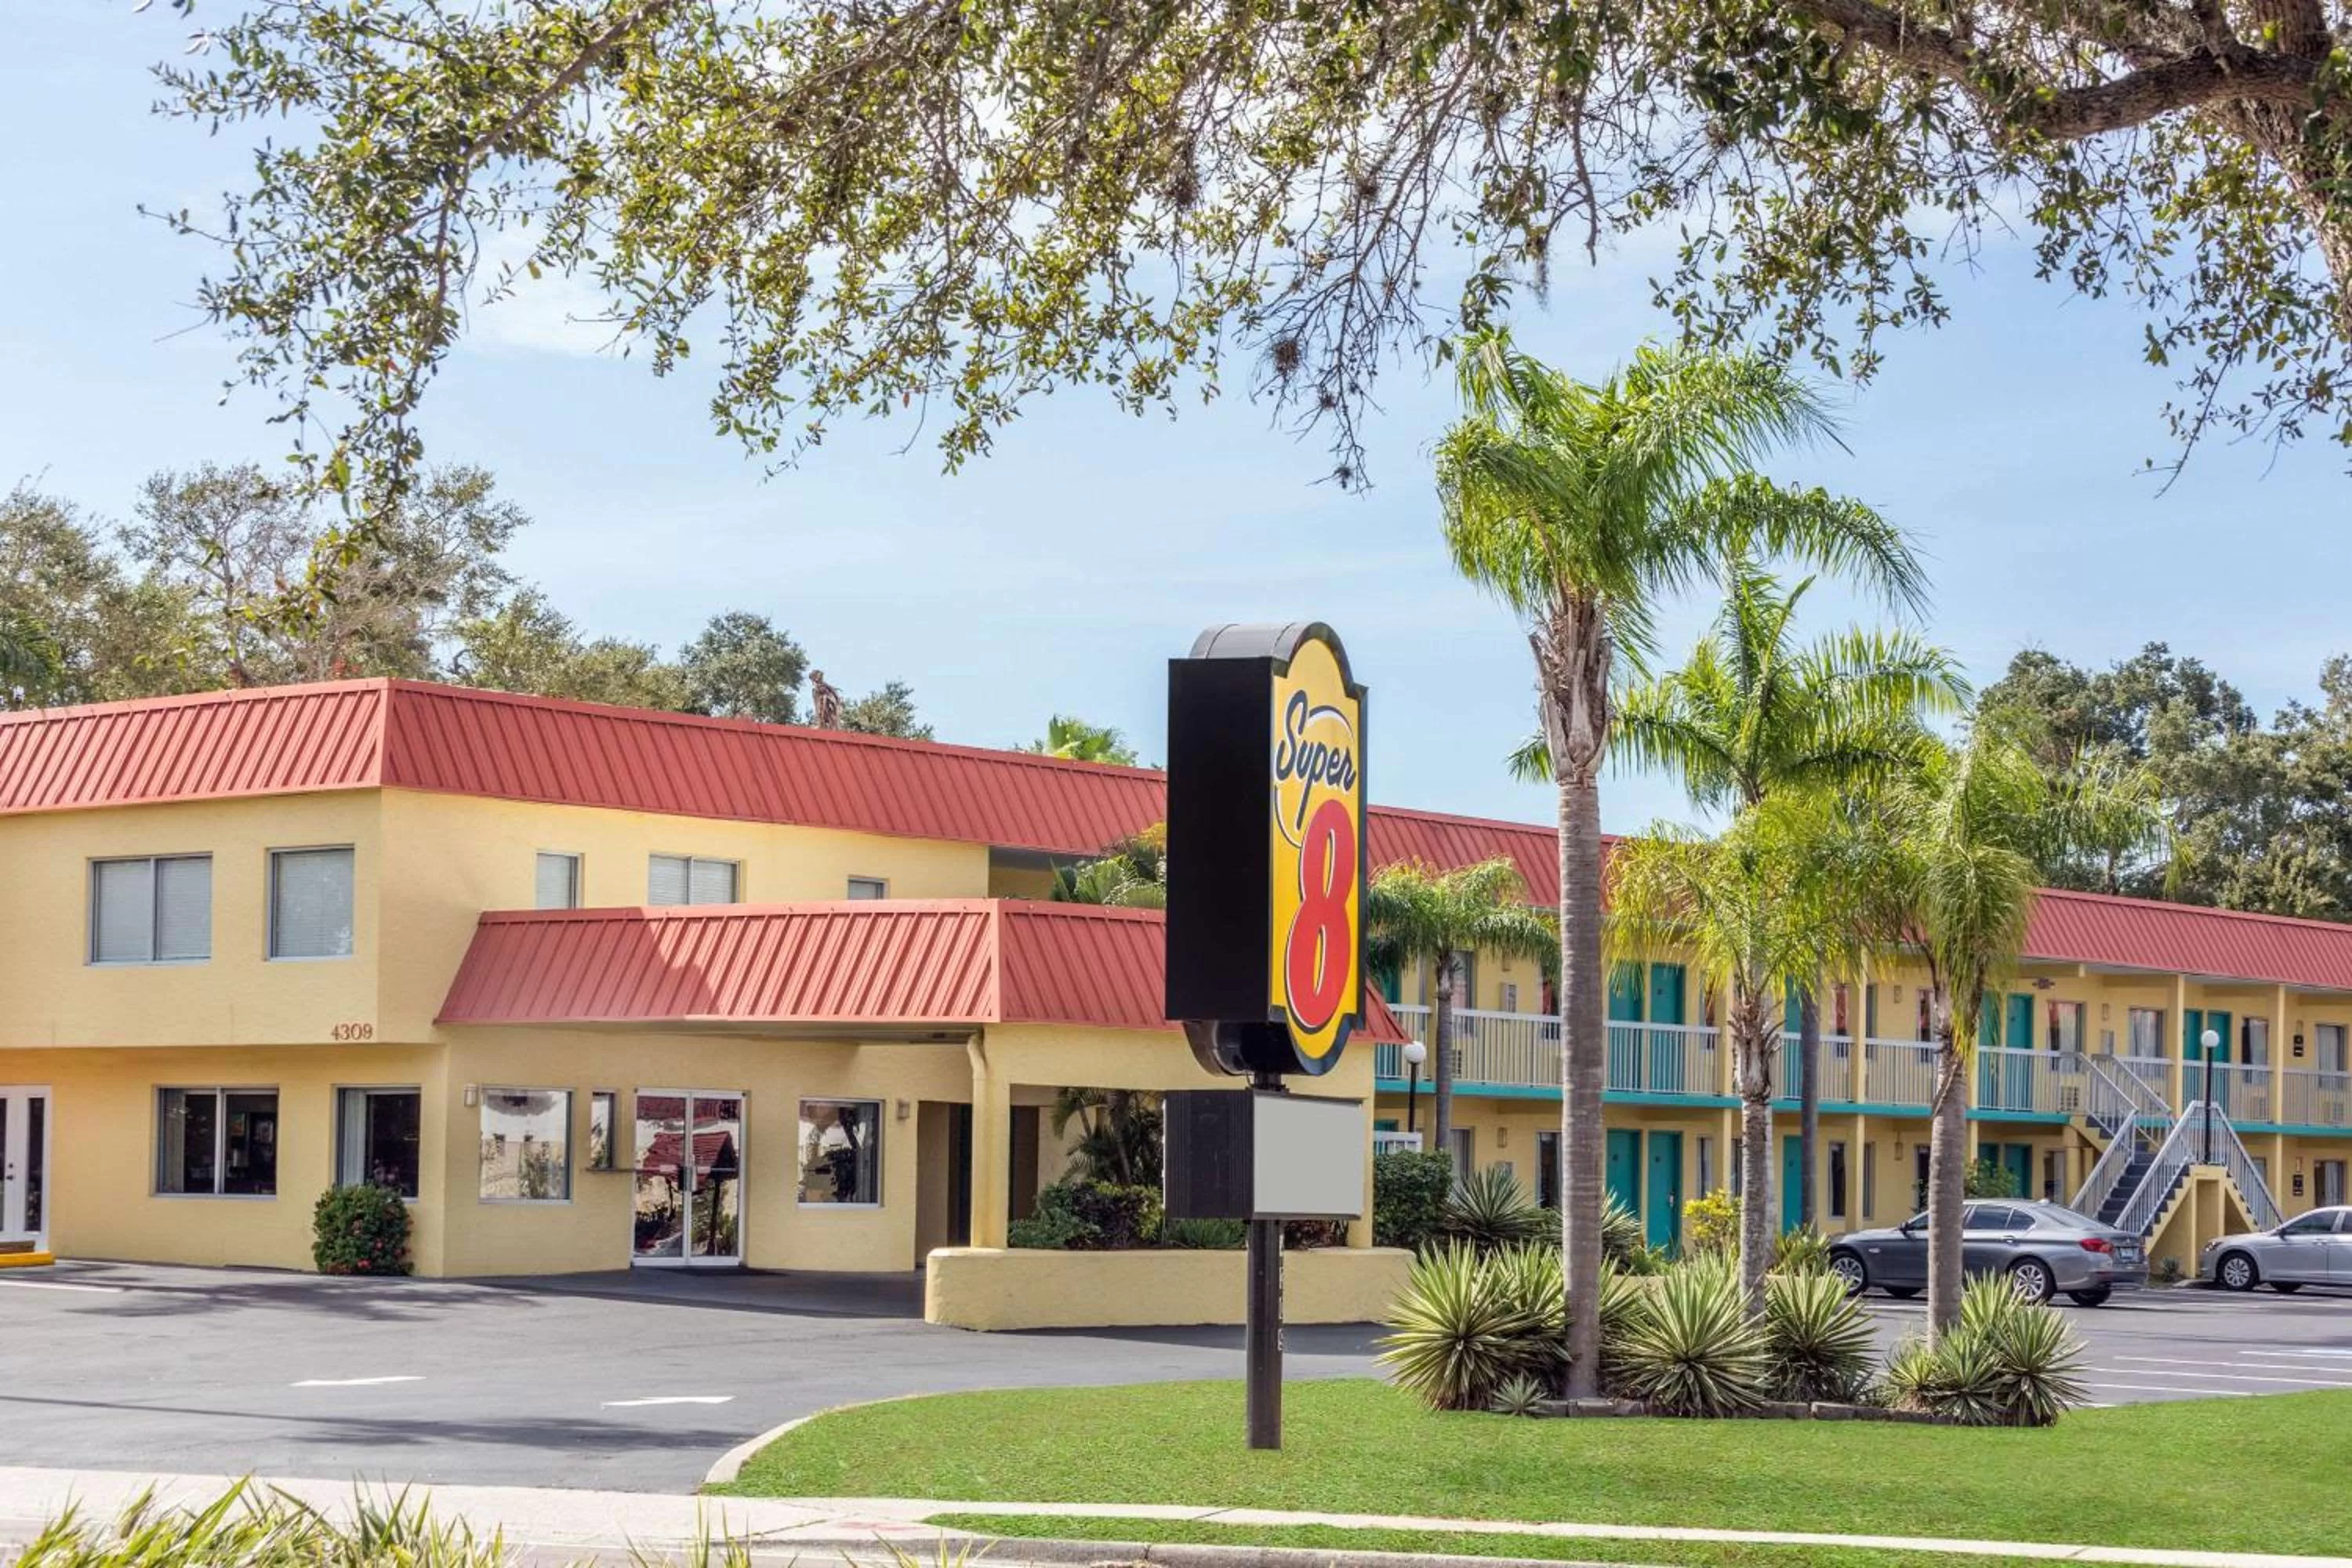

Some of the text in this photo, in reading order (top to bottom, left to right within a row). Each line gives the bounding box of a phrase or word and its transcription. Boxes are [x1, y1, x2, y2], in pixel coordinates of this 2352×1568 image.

[1276, 689, 1356, 830] Super
[1285, 799, 1356, 1032] 8
[330, 1022, 373, 1041] 4309
